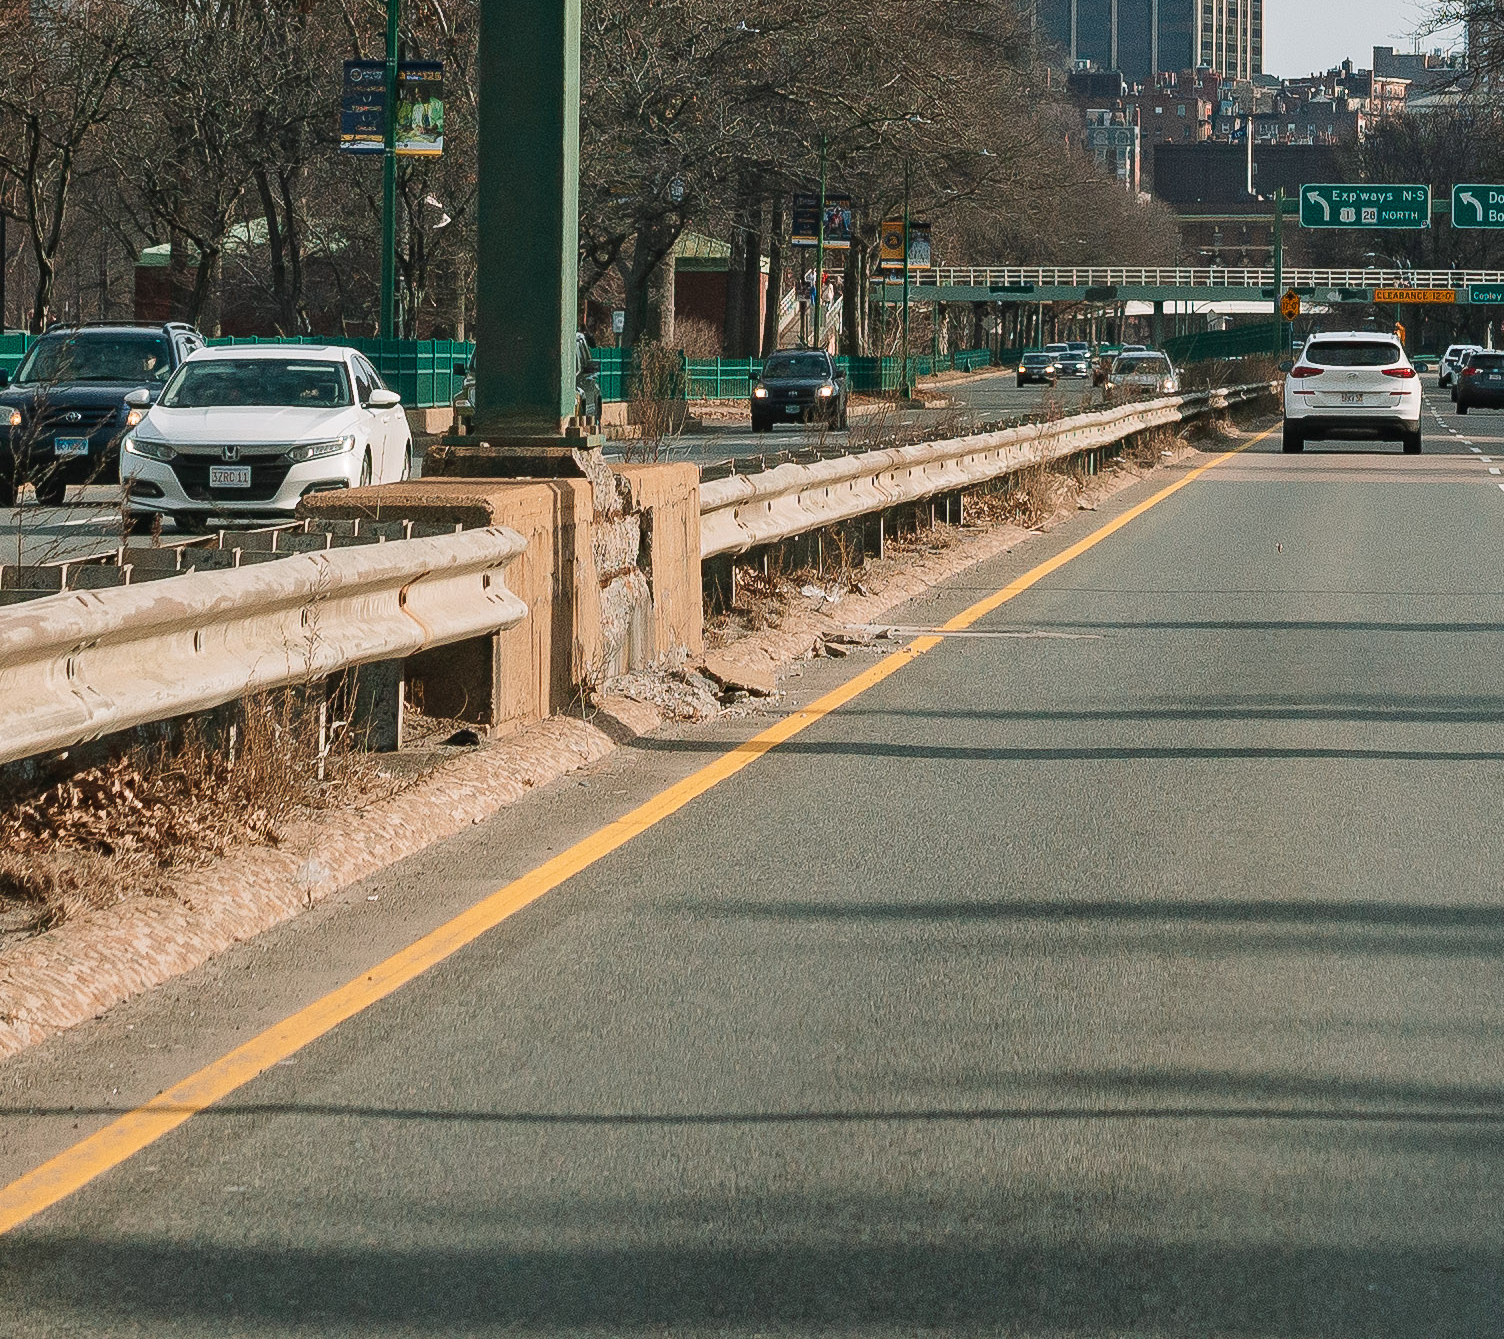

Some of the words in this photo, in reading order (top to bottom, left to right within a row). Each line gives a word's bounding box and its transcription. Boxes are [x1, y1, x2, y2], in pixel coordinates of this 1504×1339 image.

[1332, 190, 1394, 203] Exp'ways
[1402, 190, 1425, 201] N-S
[1382, 211, 1418, 220] NORTH
[1376, 291, 1428, 300] CLEARANCE
[1473, 291, 1502, 302] Copley
